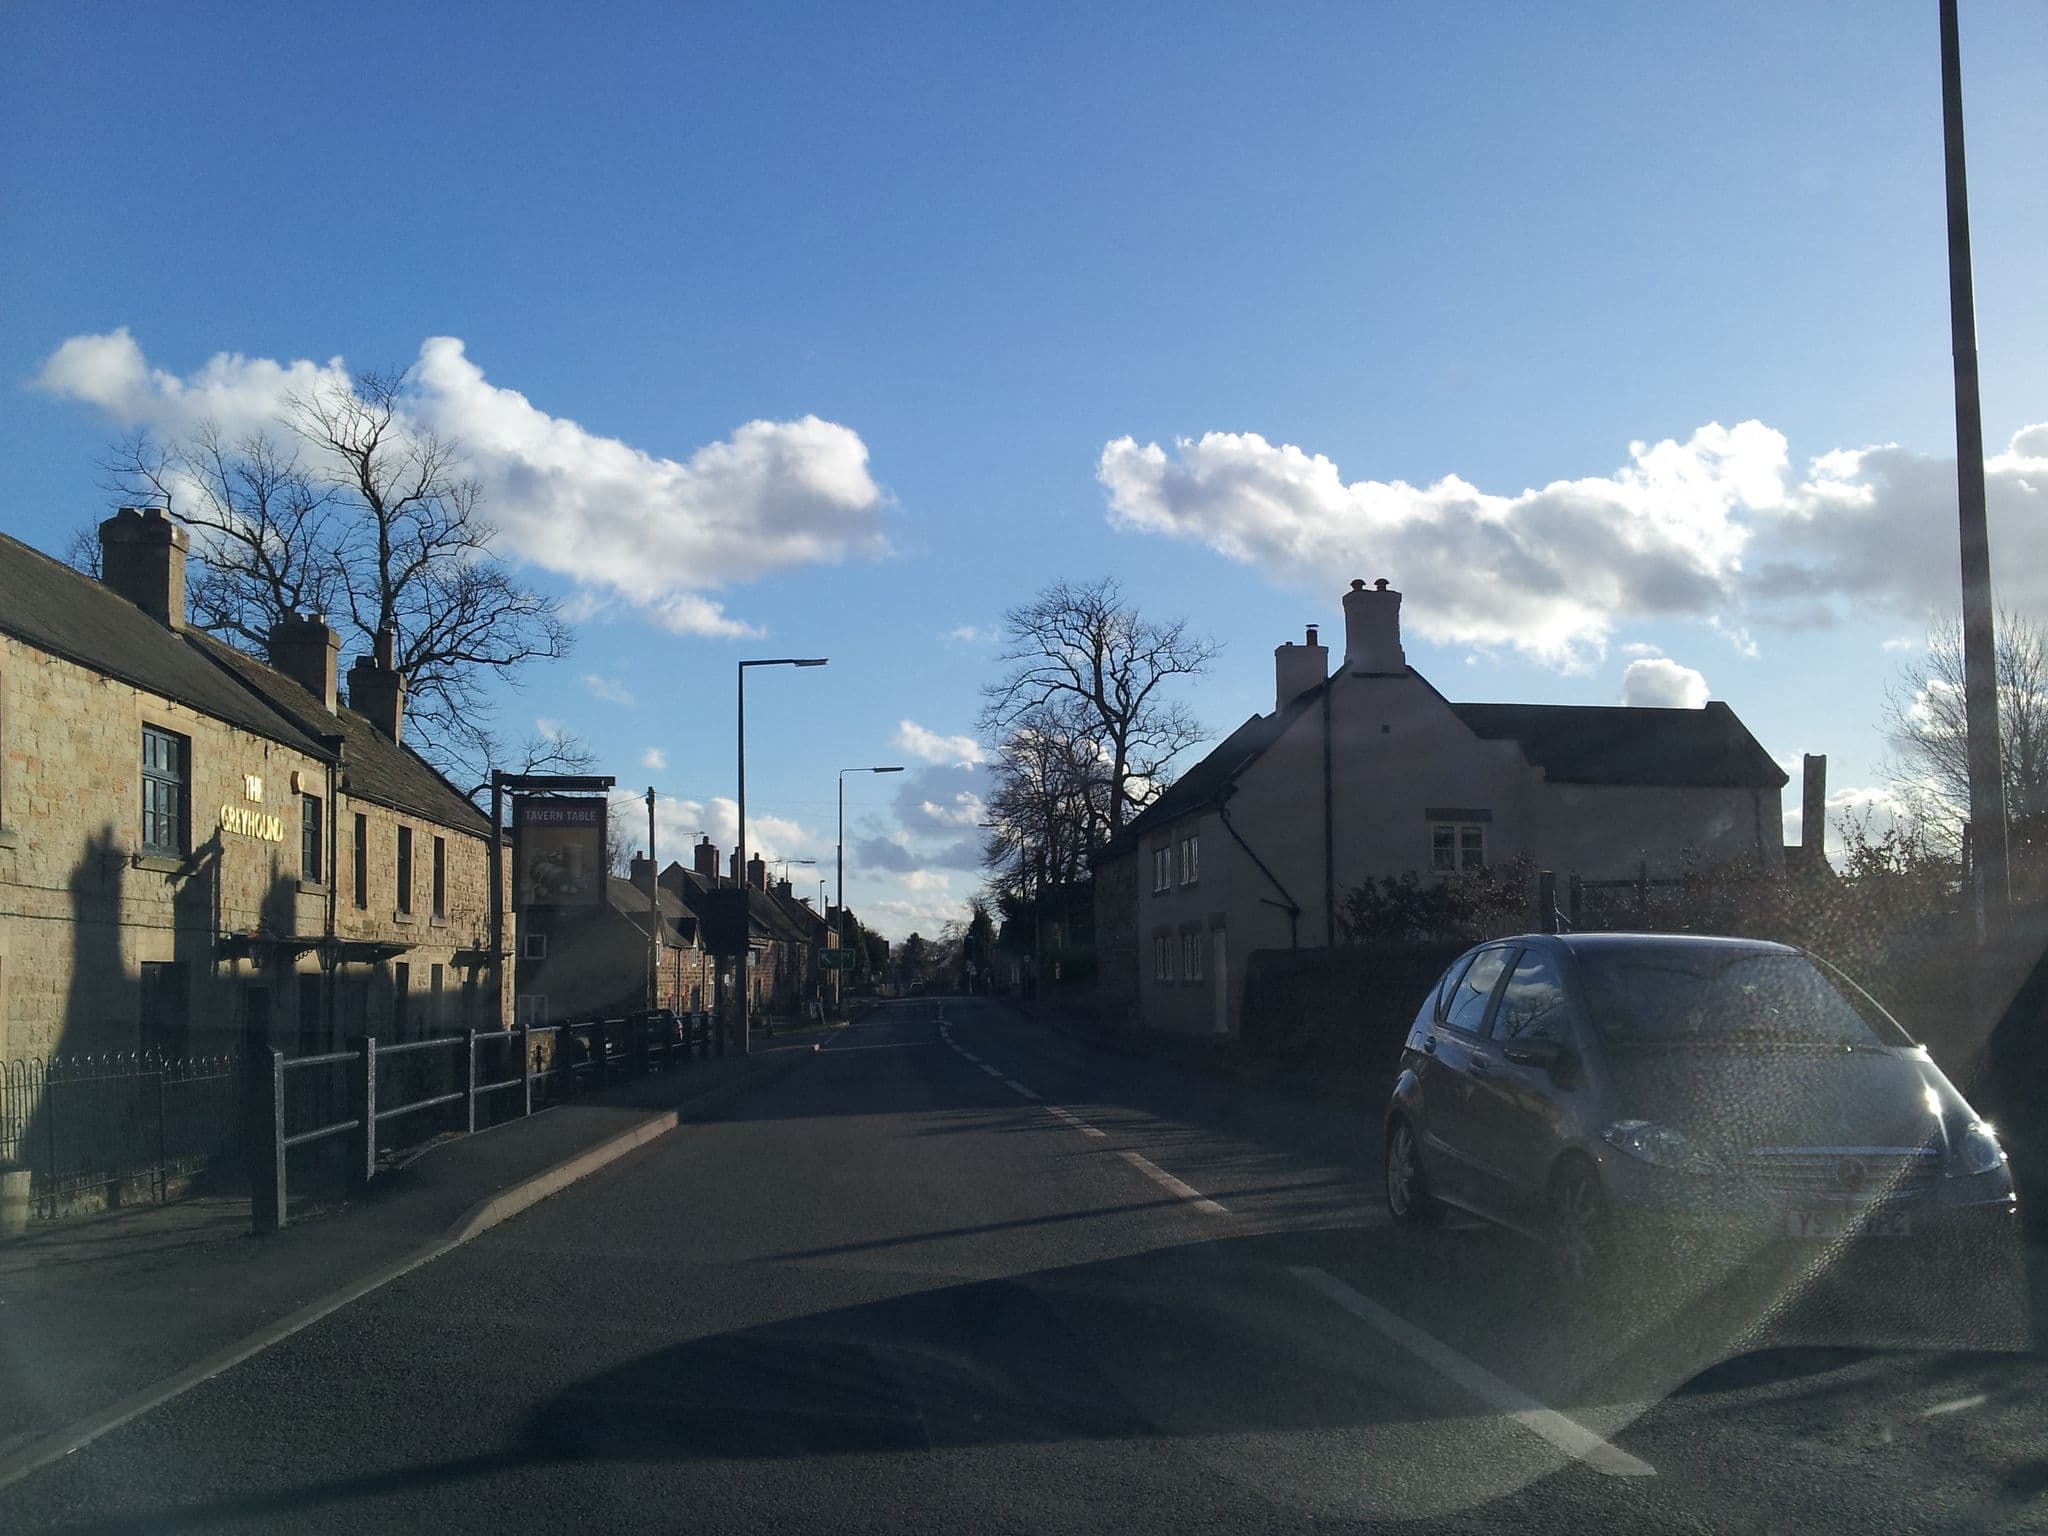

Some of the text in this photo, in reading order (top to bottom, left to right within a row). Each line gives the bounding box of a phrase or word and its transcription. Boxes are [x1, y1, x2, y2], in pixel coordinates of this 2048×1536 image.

[244, 774, 263, 802] THE
[220, 804, 284, 842] GREYHOUND
[526, 810, 597, 821] TAVERN TABLE
